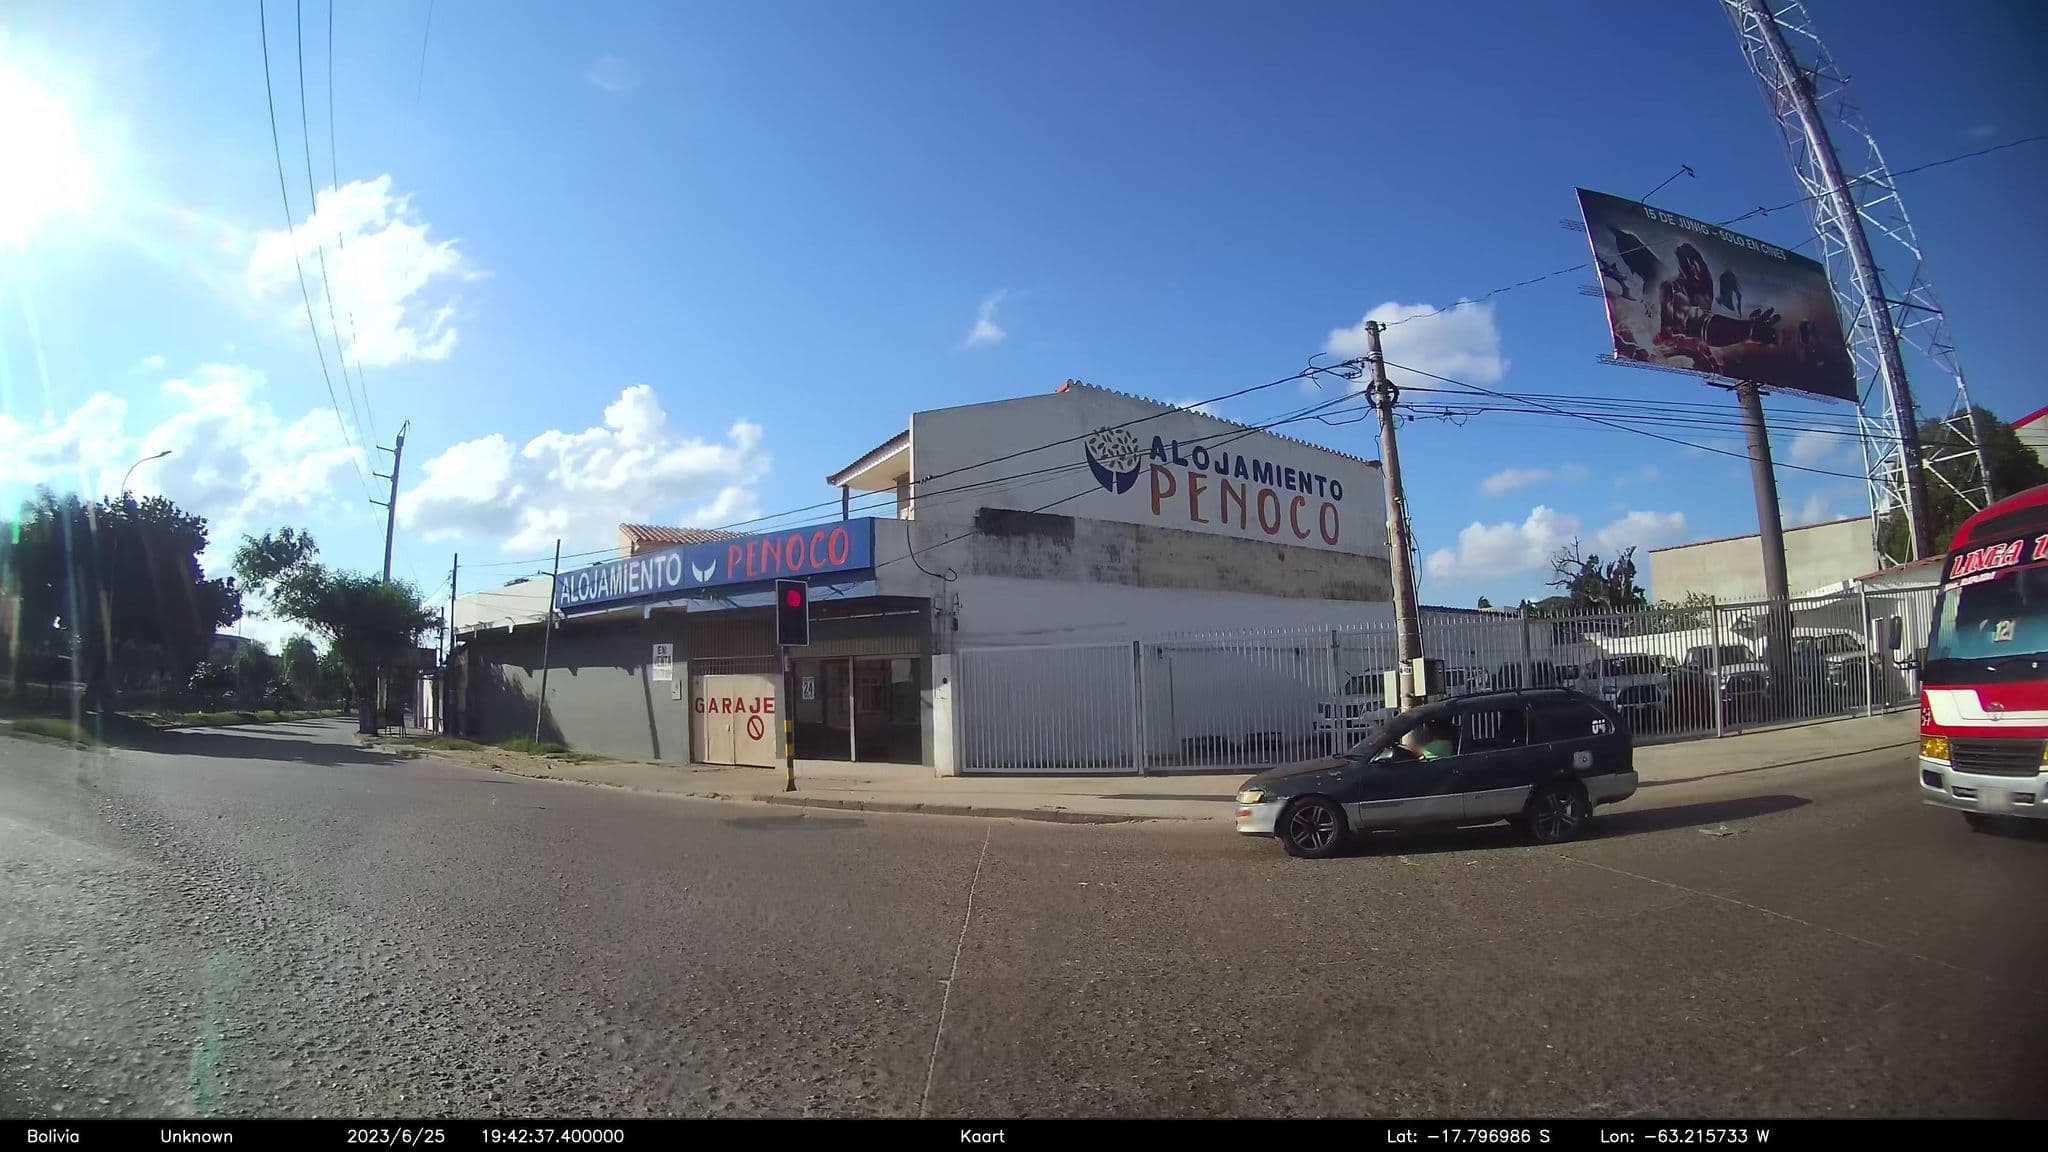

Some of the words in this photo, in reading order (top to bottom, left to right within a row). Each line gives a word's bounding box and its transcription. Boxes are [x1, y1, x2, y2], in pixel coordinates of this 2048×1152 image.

[1643, 206, 1657, 220] 15
[1659, 211, 1676, 226] DE
[1678, 217, 1710, 236] JUNIO
[1720, 230, 1745, 247] SOLO
[1746, 238, 1760, 252] EN
[1761, 243, 1787, 260] CINES
[1150, 435, 1343, 501] ALOJAMIENTO
[1150, 464, 1339, 546] PENOCO
[560, 553, 682, 605] ALOJAMIENTO
[726, 527, 849, 579] PENOCO
[1949, 540, 2024, 580] LINEA
[2032, 533, 2048, 561] 1
[695, 696, 775, 714] GARAJE
